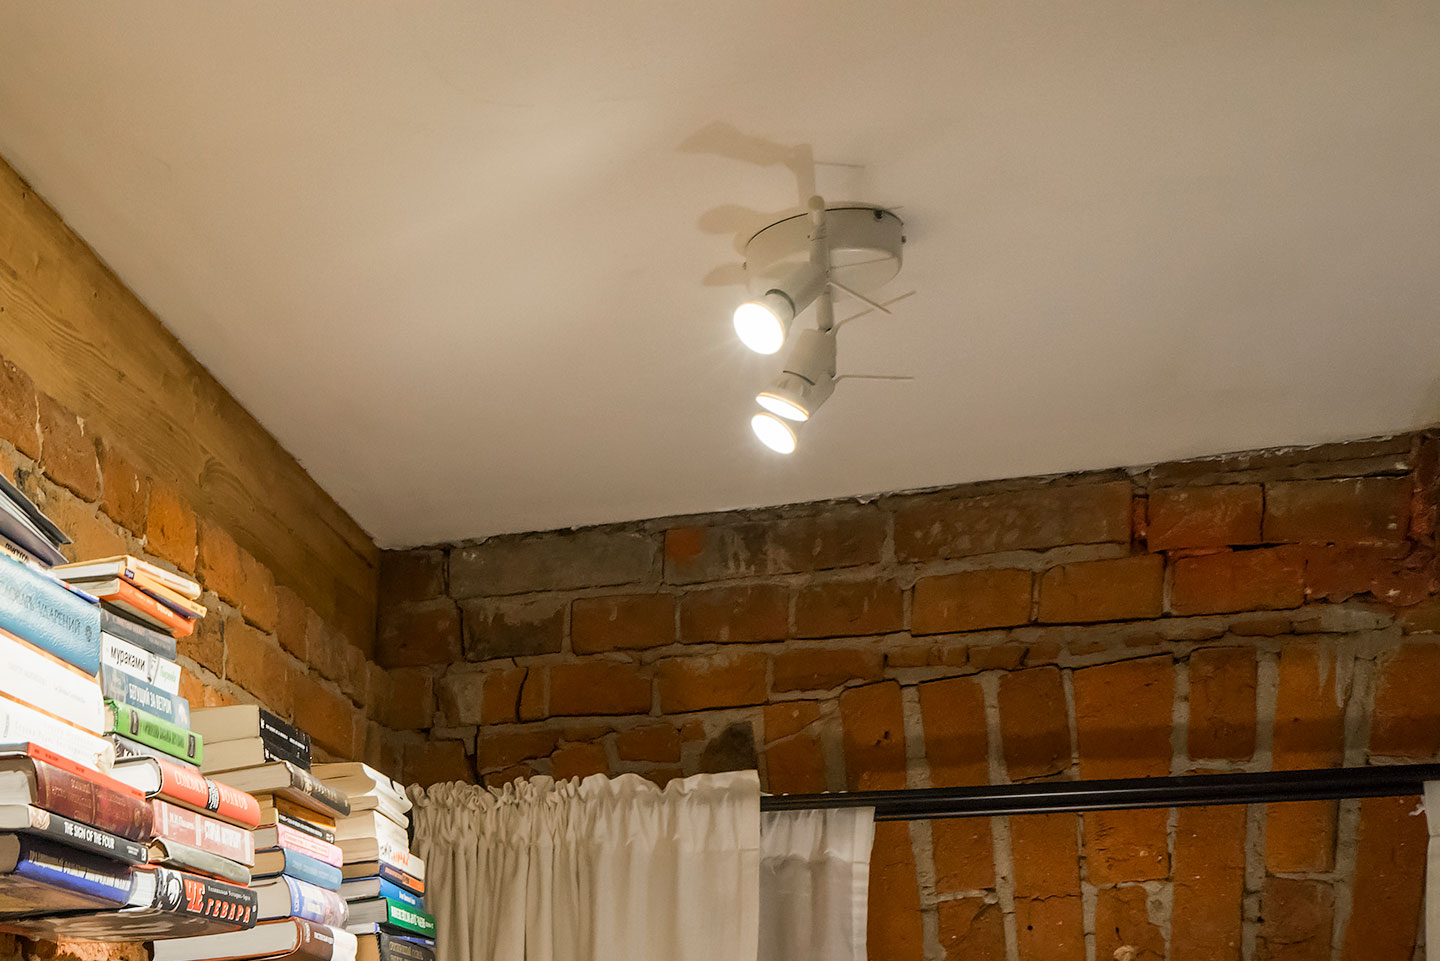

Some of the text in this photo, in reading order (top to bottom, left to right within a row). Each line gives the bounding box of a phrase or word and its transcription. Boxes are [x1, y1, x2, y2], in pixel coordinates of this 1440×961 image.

[64, 821, 73, 836] THE
[74, 825, 86, 840] SIGN
[101, 834, 114, 849] FOUR
[184, 879, 205, 913] ЧЕ
[205, 898, 251, 923] ГЕВАРА
